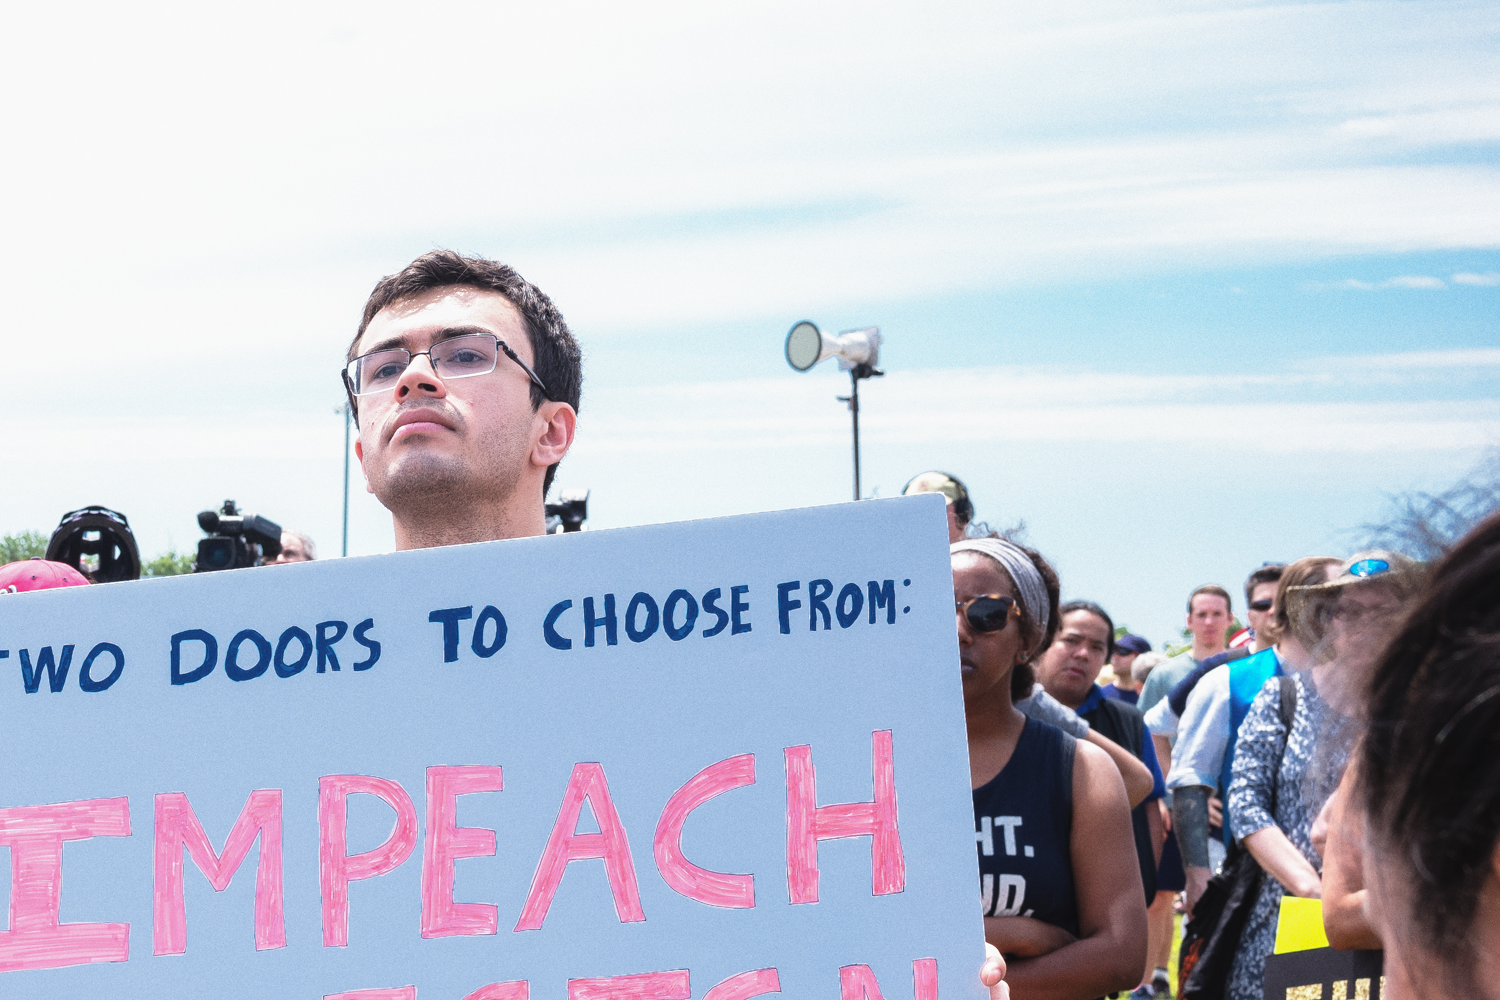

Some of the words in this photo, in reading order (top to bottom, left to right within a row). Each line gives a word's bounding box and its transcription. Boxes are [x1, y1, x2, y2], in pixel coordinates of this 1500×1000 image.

[169, 615, 383, 686] DOORS
[428, 604, 508, 663] TO
[541, 579, 752, 652] CHOOSE
[777, 578, 913, 635] FROM:
